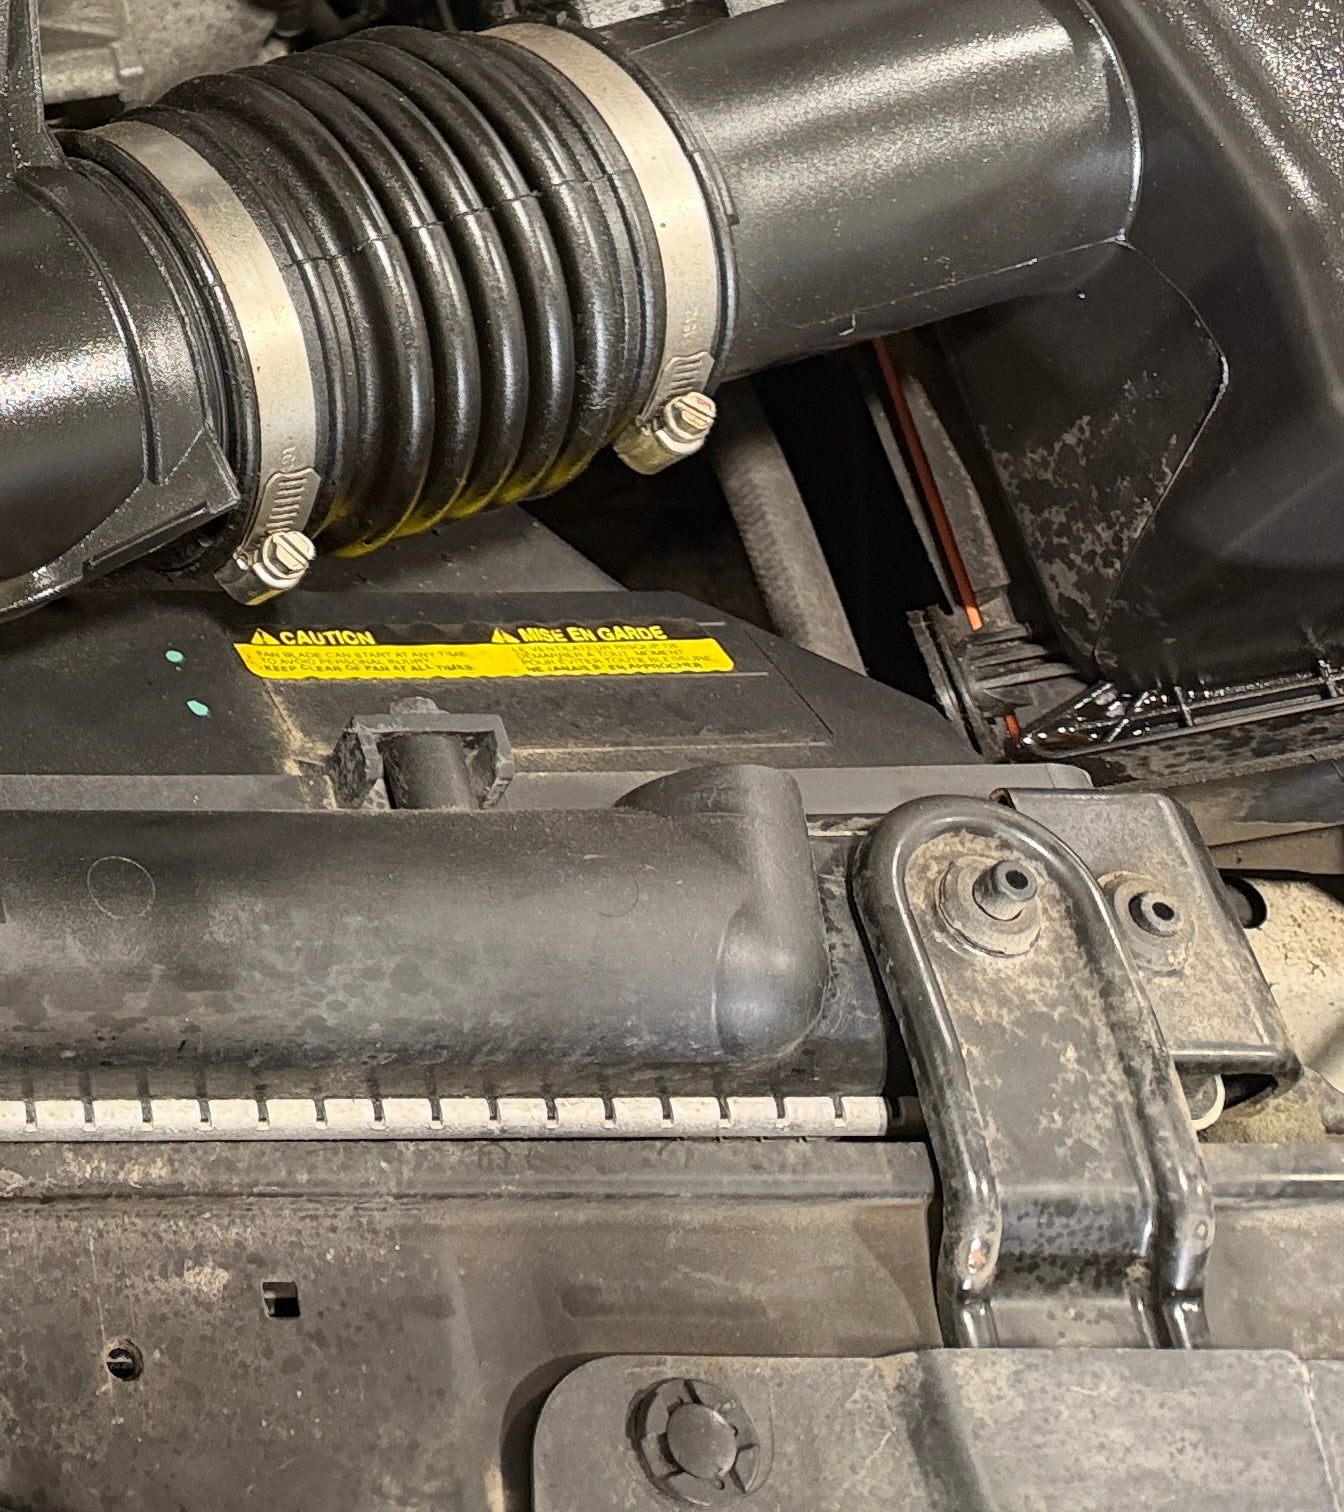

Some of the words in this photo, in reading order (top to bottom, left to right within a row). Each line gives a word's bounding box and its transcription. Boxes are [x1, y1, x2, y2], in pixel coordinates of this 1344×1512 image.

[279, 629, 377, 645] CAUTION
[517, 627, 567, 643] MISE
[566, 626, 598, 642] EN
[596, 625, 668, 641] GARDE
